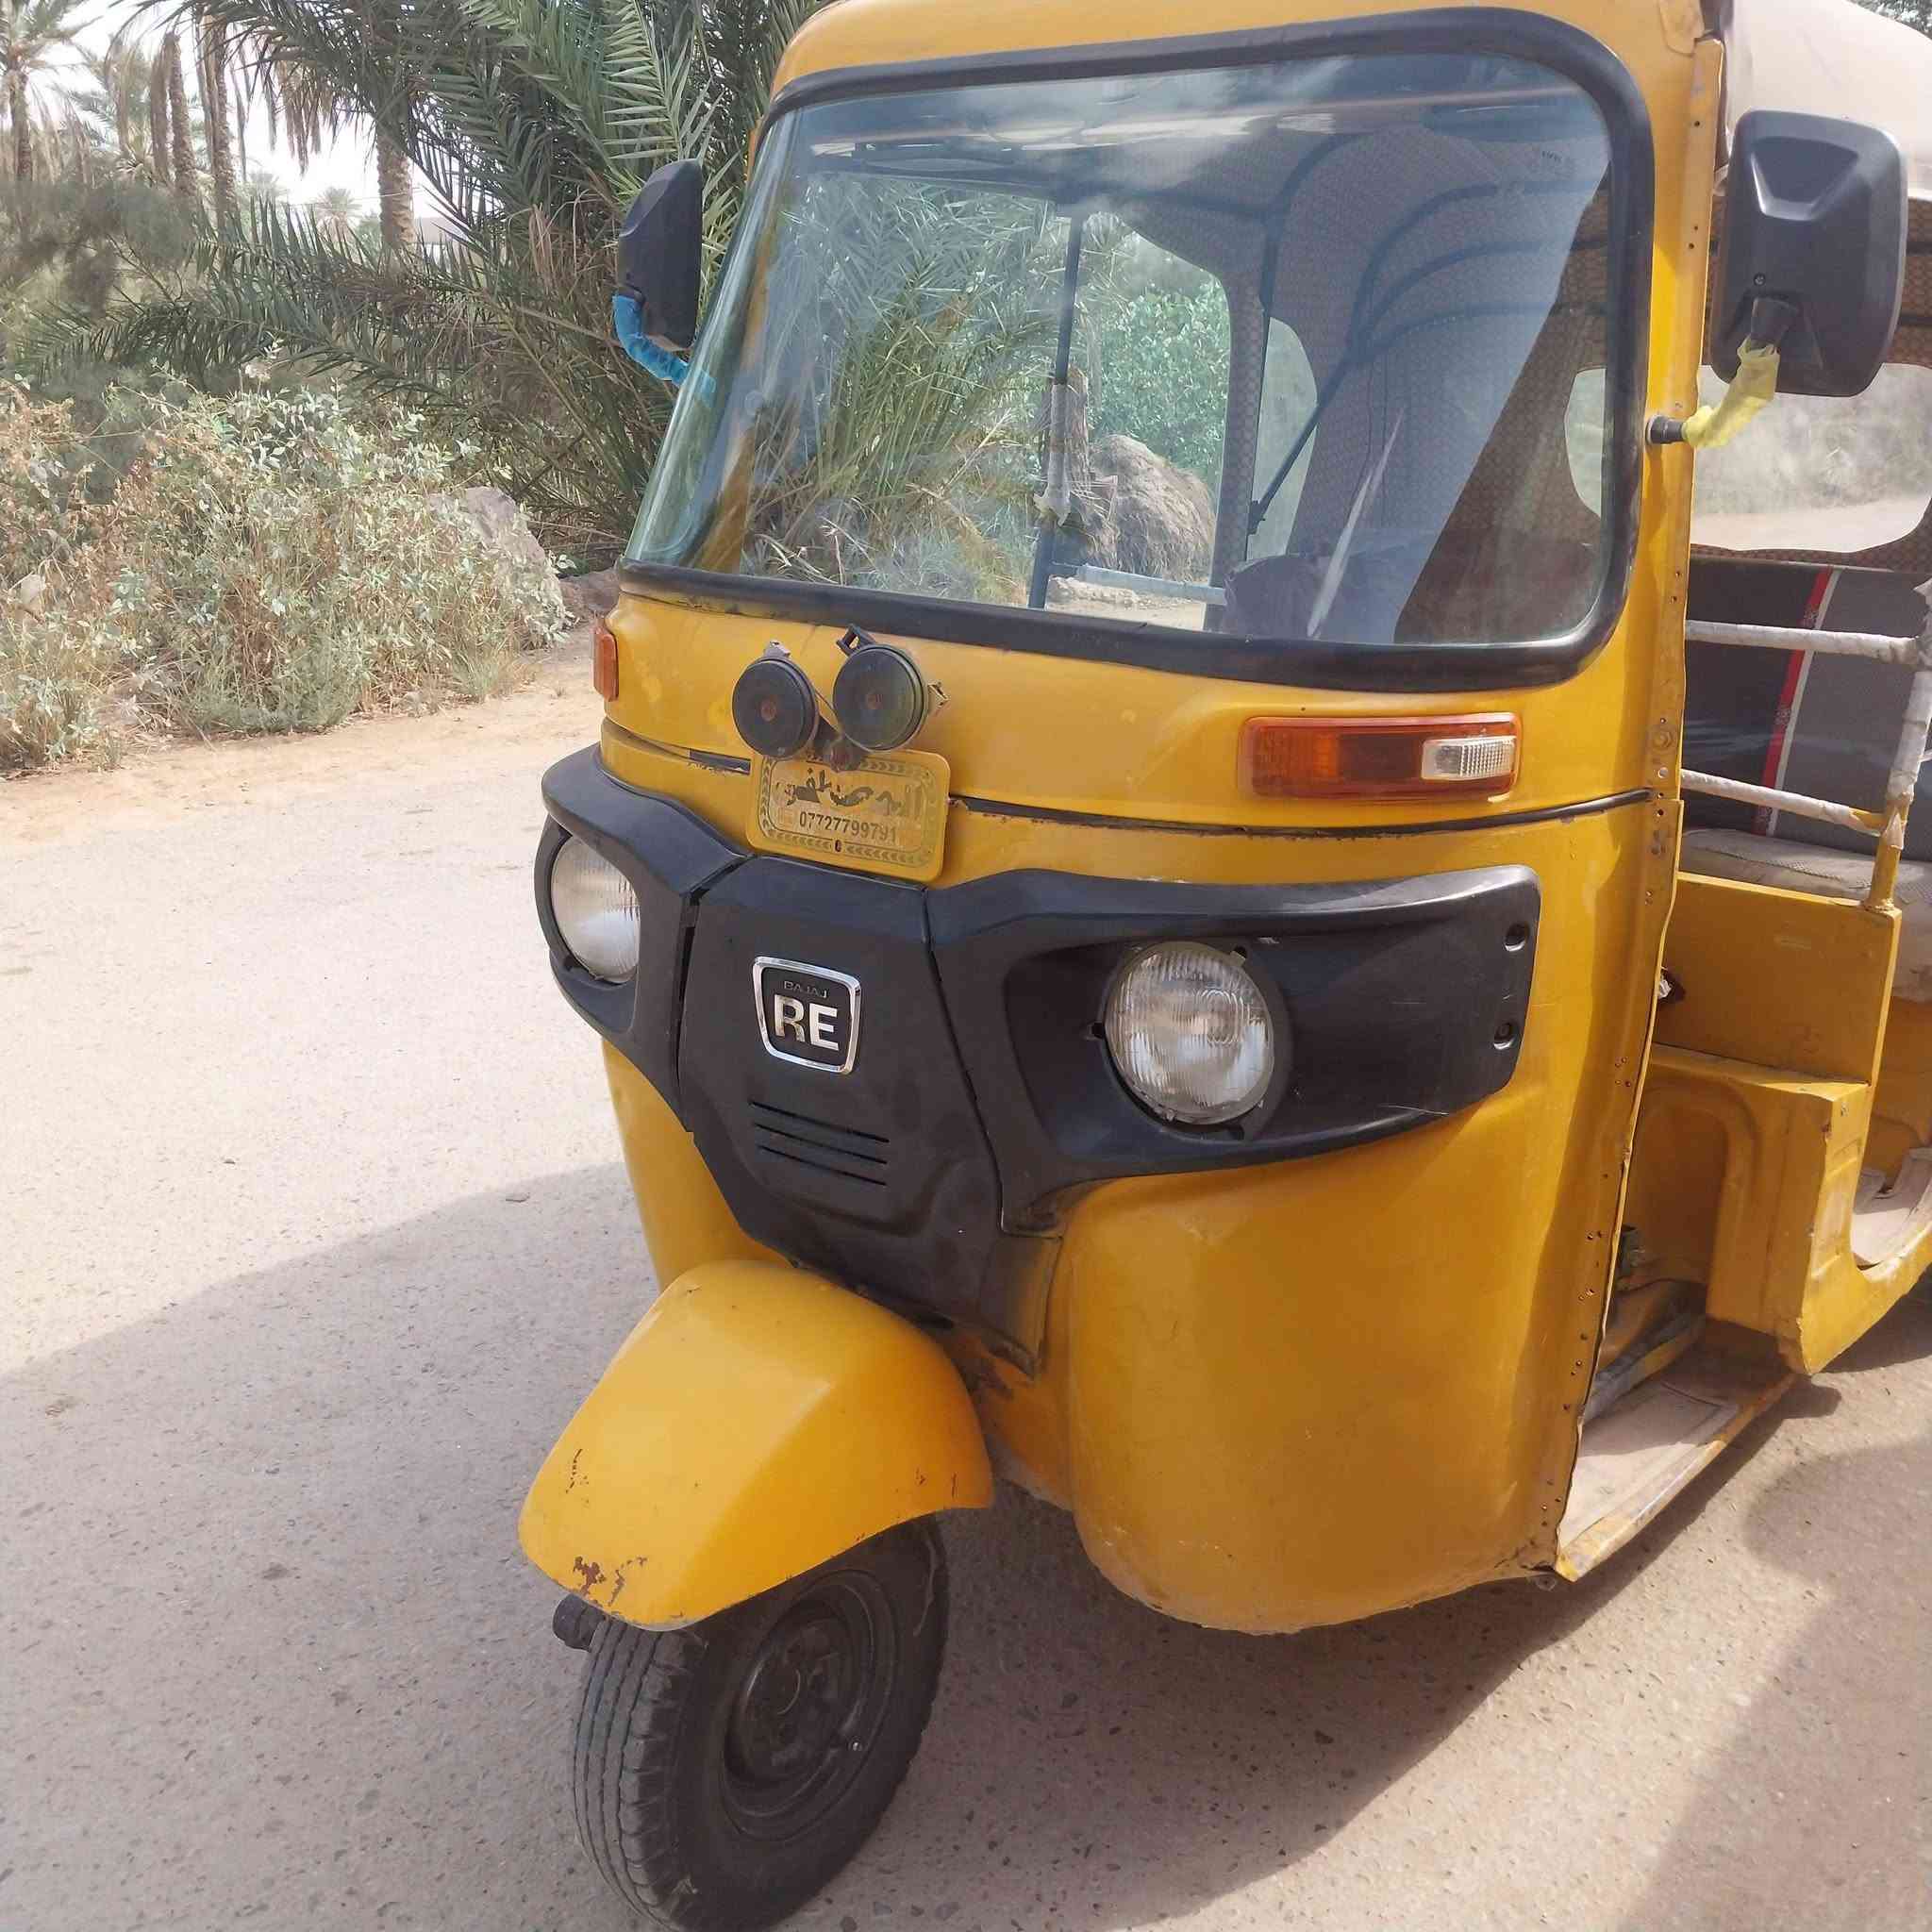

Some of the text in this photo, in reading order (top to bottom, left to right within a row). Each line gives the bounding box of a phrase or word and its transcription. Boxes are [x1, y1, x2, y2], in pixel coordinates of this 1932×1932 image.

[799, 811, 897, 844] 07727799791
[784, 980, 828, 999] BAJAJ
[774, 993, 840, 1051] RE
